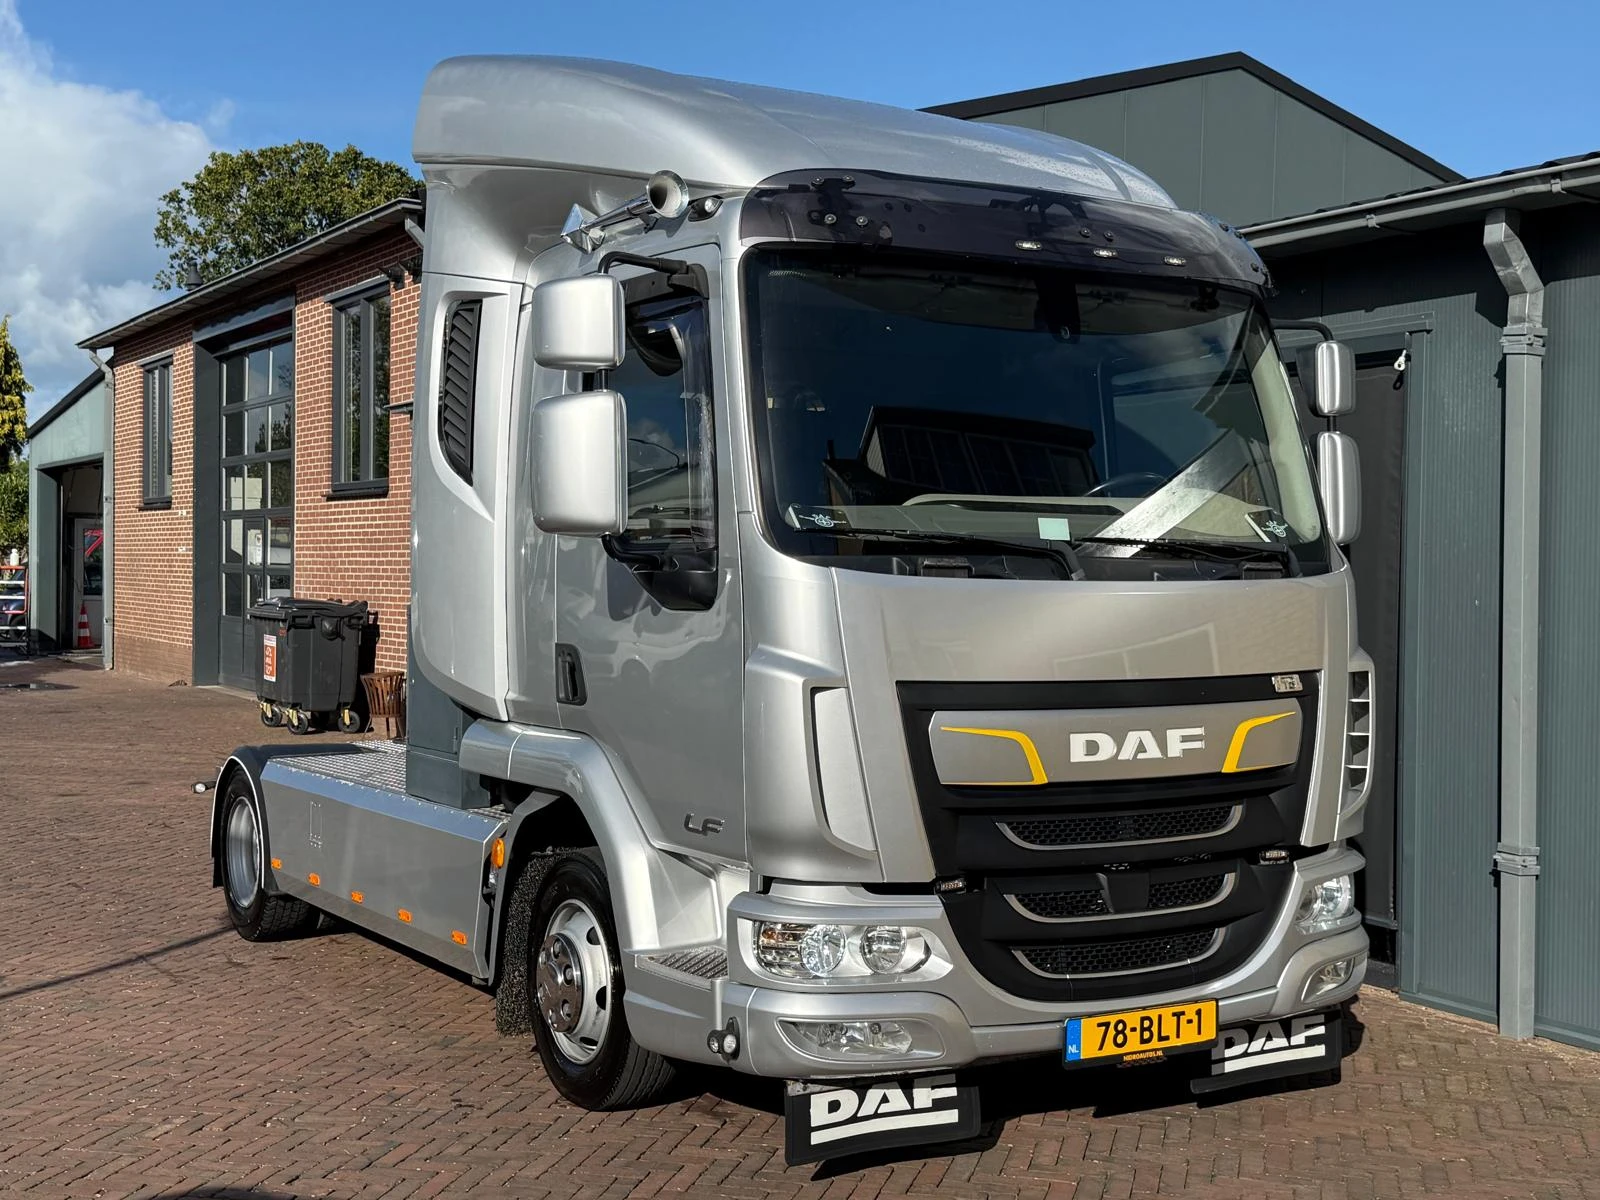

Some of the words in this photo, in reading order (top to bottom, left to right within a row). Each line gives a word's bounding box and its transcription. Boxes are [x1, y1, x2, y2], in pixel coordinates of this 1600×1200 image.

[1069, 726, 1206, 763] DAF
[684, 813, 725, 836] LF
[1068, 1044, 1080, 1054] NL
[1096, 1008, 1203, 1052] 78-BLT-1
[1211, 1014, 1326, 1060] DAF
[810, 1073, 958, 1128] DAF
